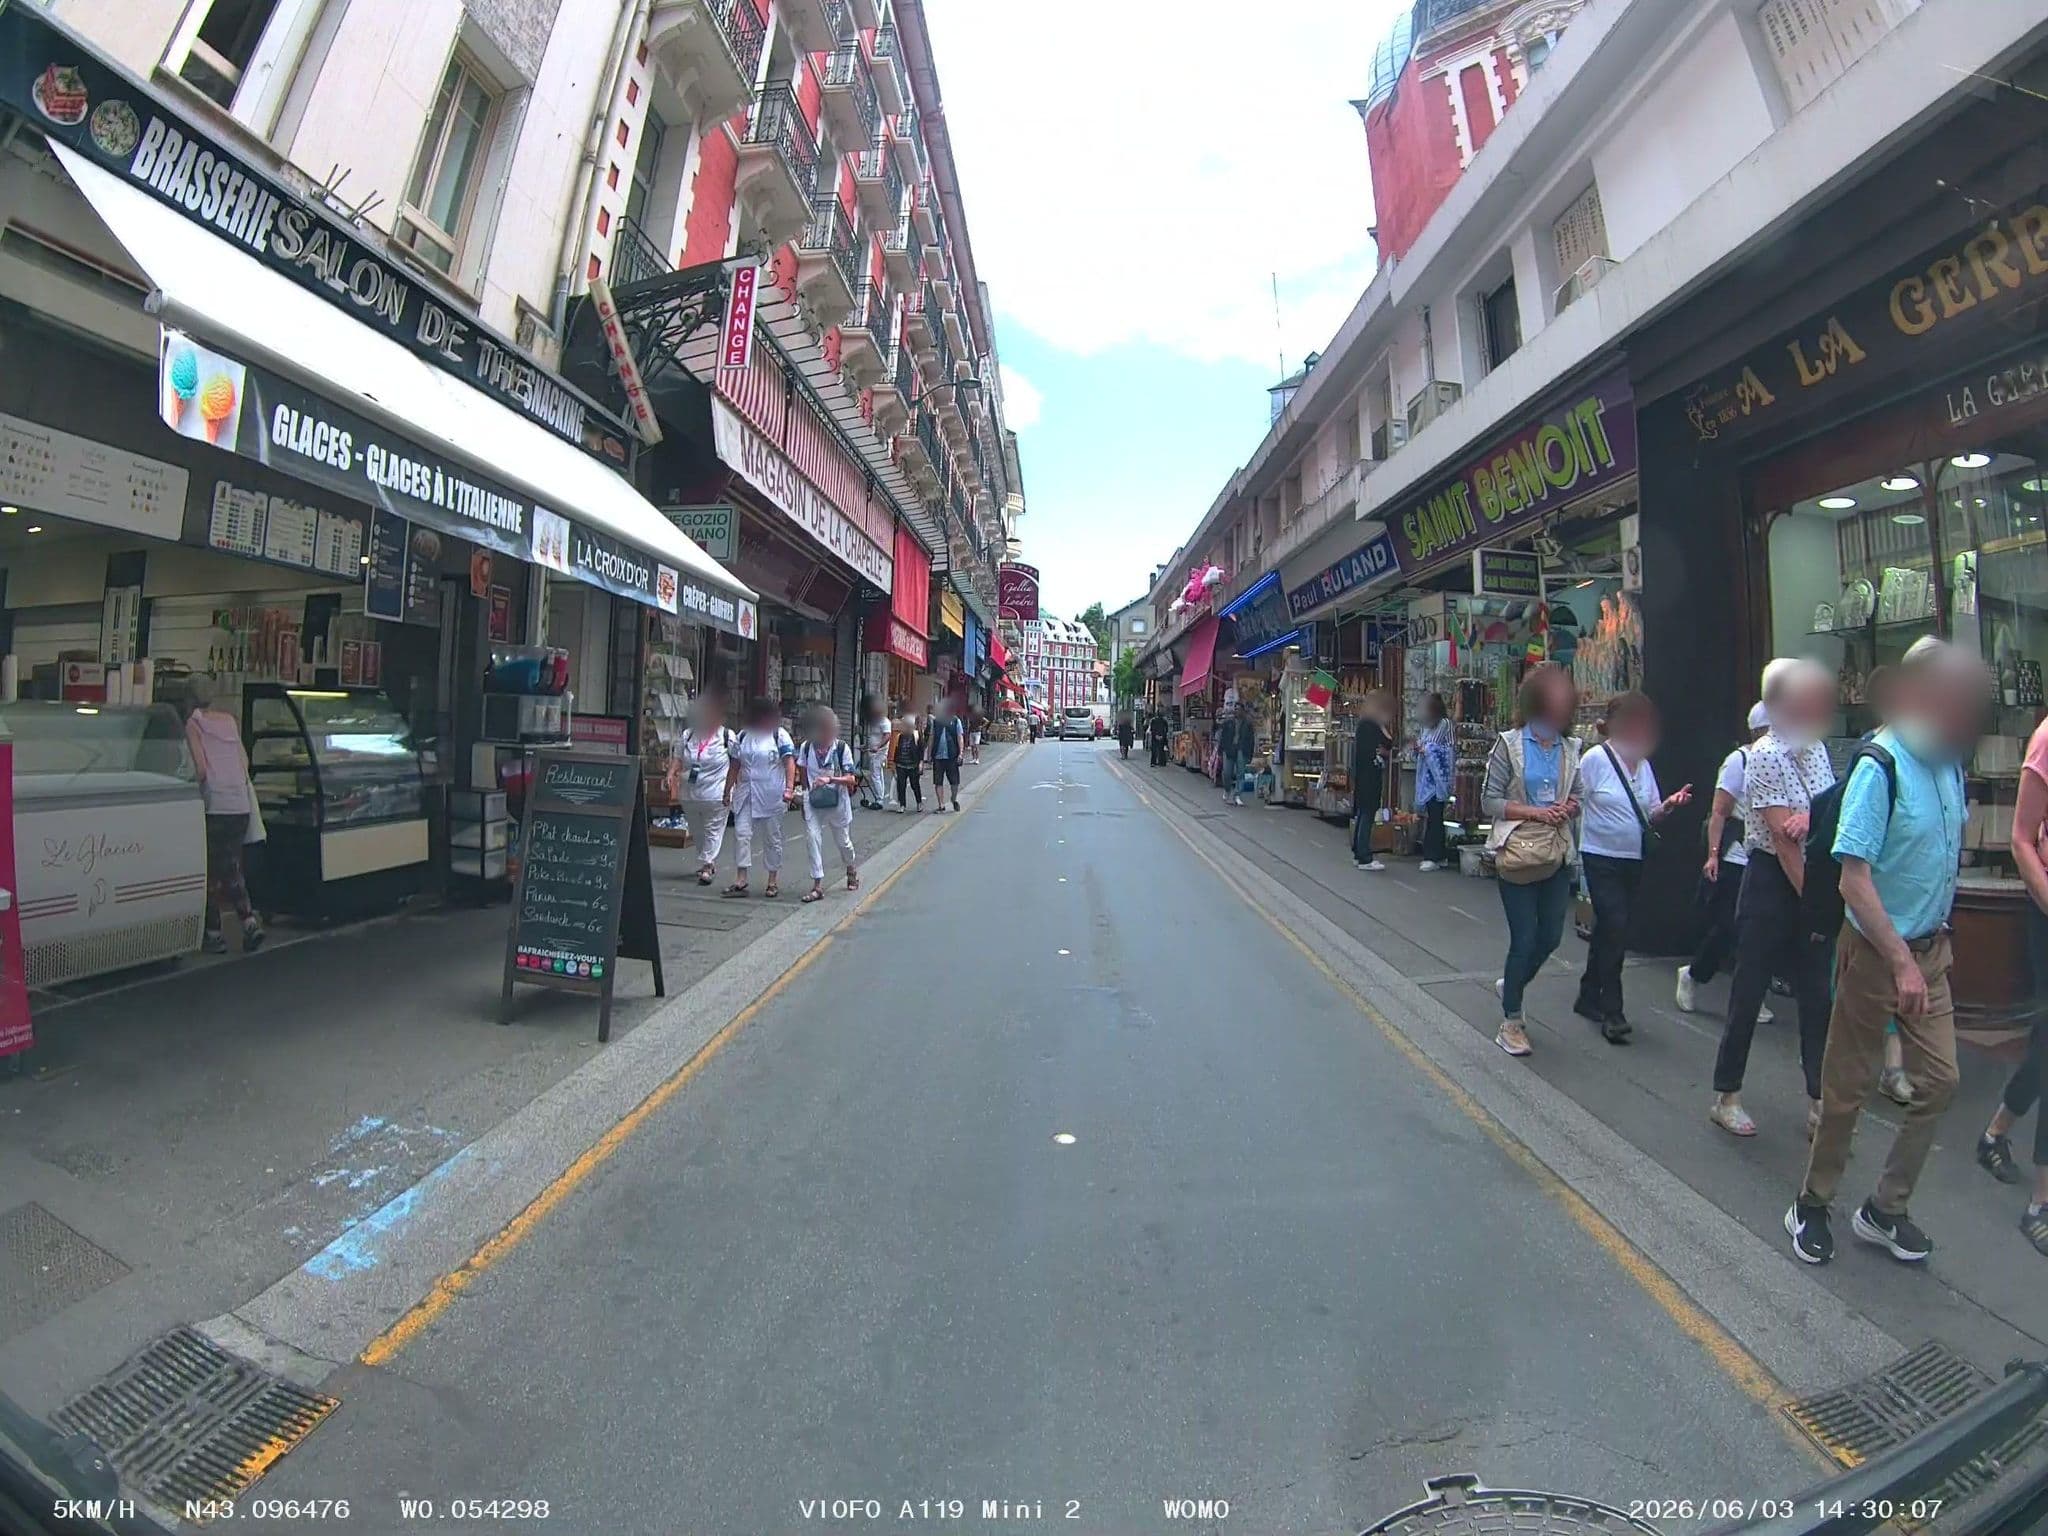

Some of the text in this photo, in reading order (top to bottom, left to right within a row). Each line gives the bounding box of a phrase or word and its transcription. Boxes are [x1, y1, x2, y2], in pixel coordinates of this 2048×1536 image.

[130, 116, 284, 252] BRASSERIE
[271, 207, 409, 326] SALON
[416, 300, 470, 363] DE
[728, 269, 752, 365] CHANGE
[523, 368, 586, 443] SNACKING
[599, 301, 649, 420] CHANGE
[1735, 366, 1776, 416] A
[1787, 316, 1868, 388] LA
[272, 403, 353, 471] GLACES
[366, 443, 432, 501] GLACES
[432, 465, 445, 507] À
[446, 476, 524, 535] L'ITALIENNE
[739, 424, 883, 583] MAGASIN DE LA CHAPELLE
[1402, 396, 1618, 562] SAINT BENOIT
[577, 540, 649, 592] LA CROIX D'OR
[1321, 543, 1388, 599] RULAND
[545, 764, 617, 790] Restaurant
